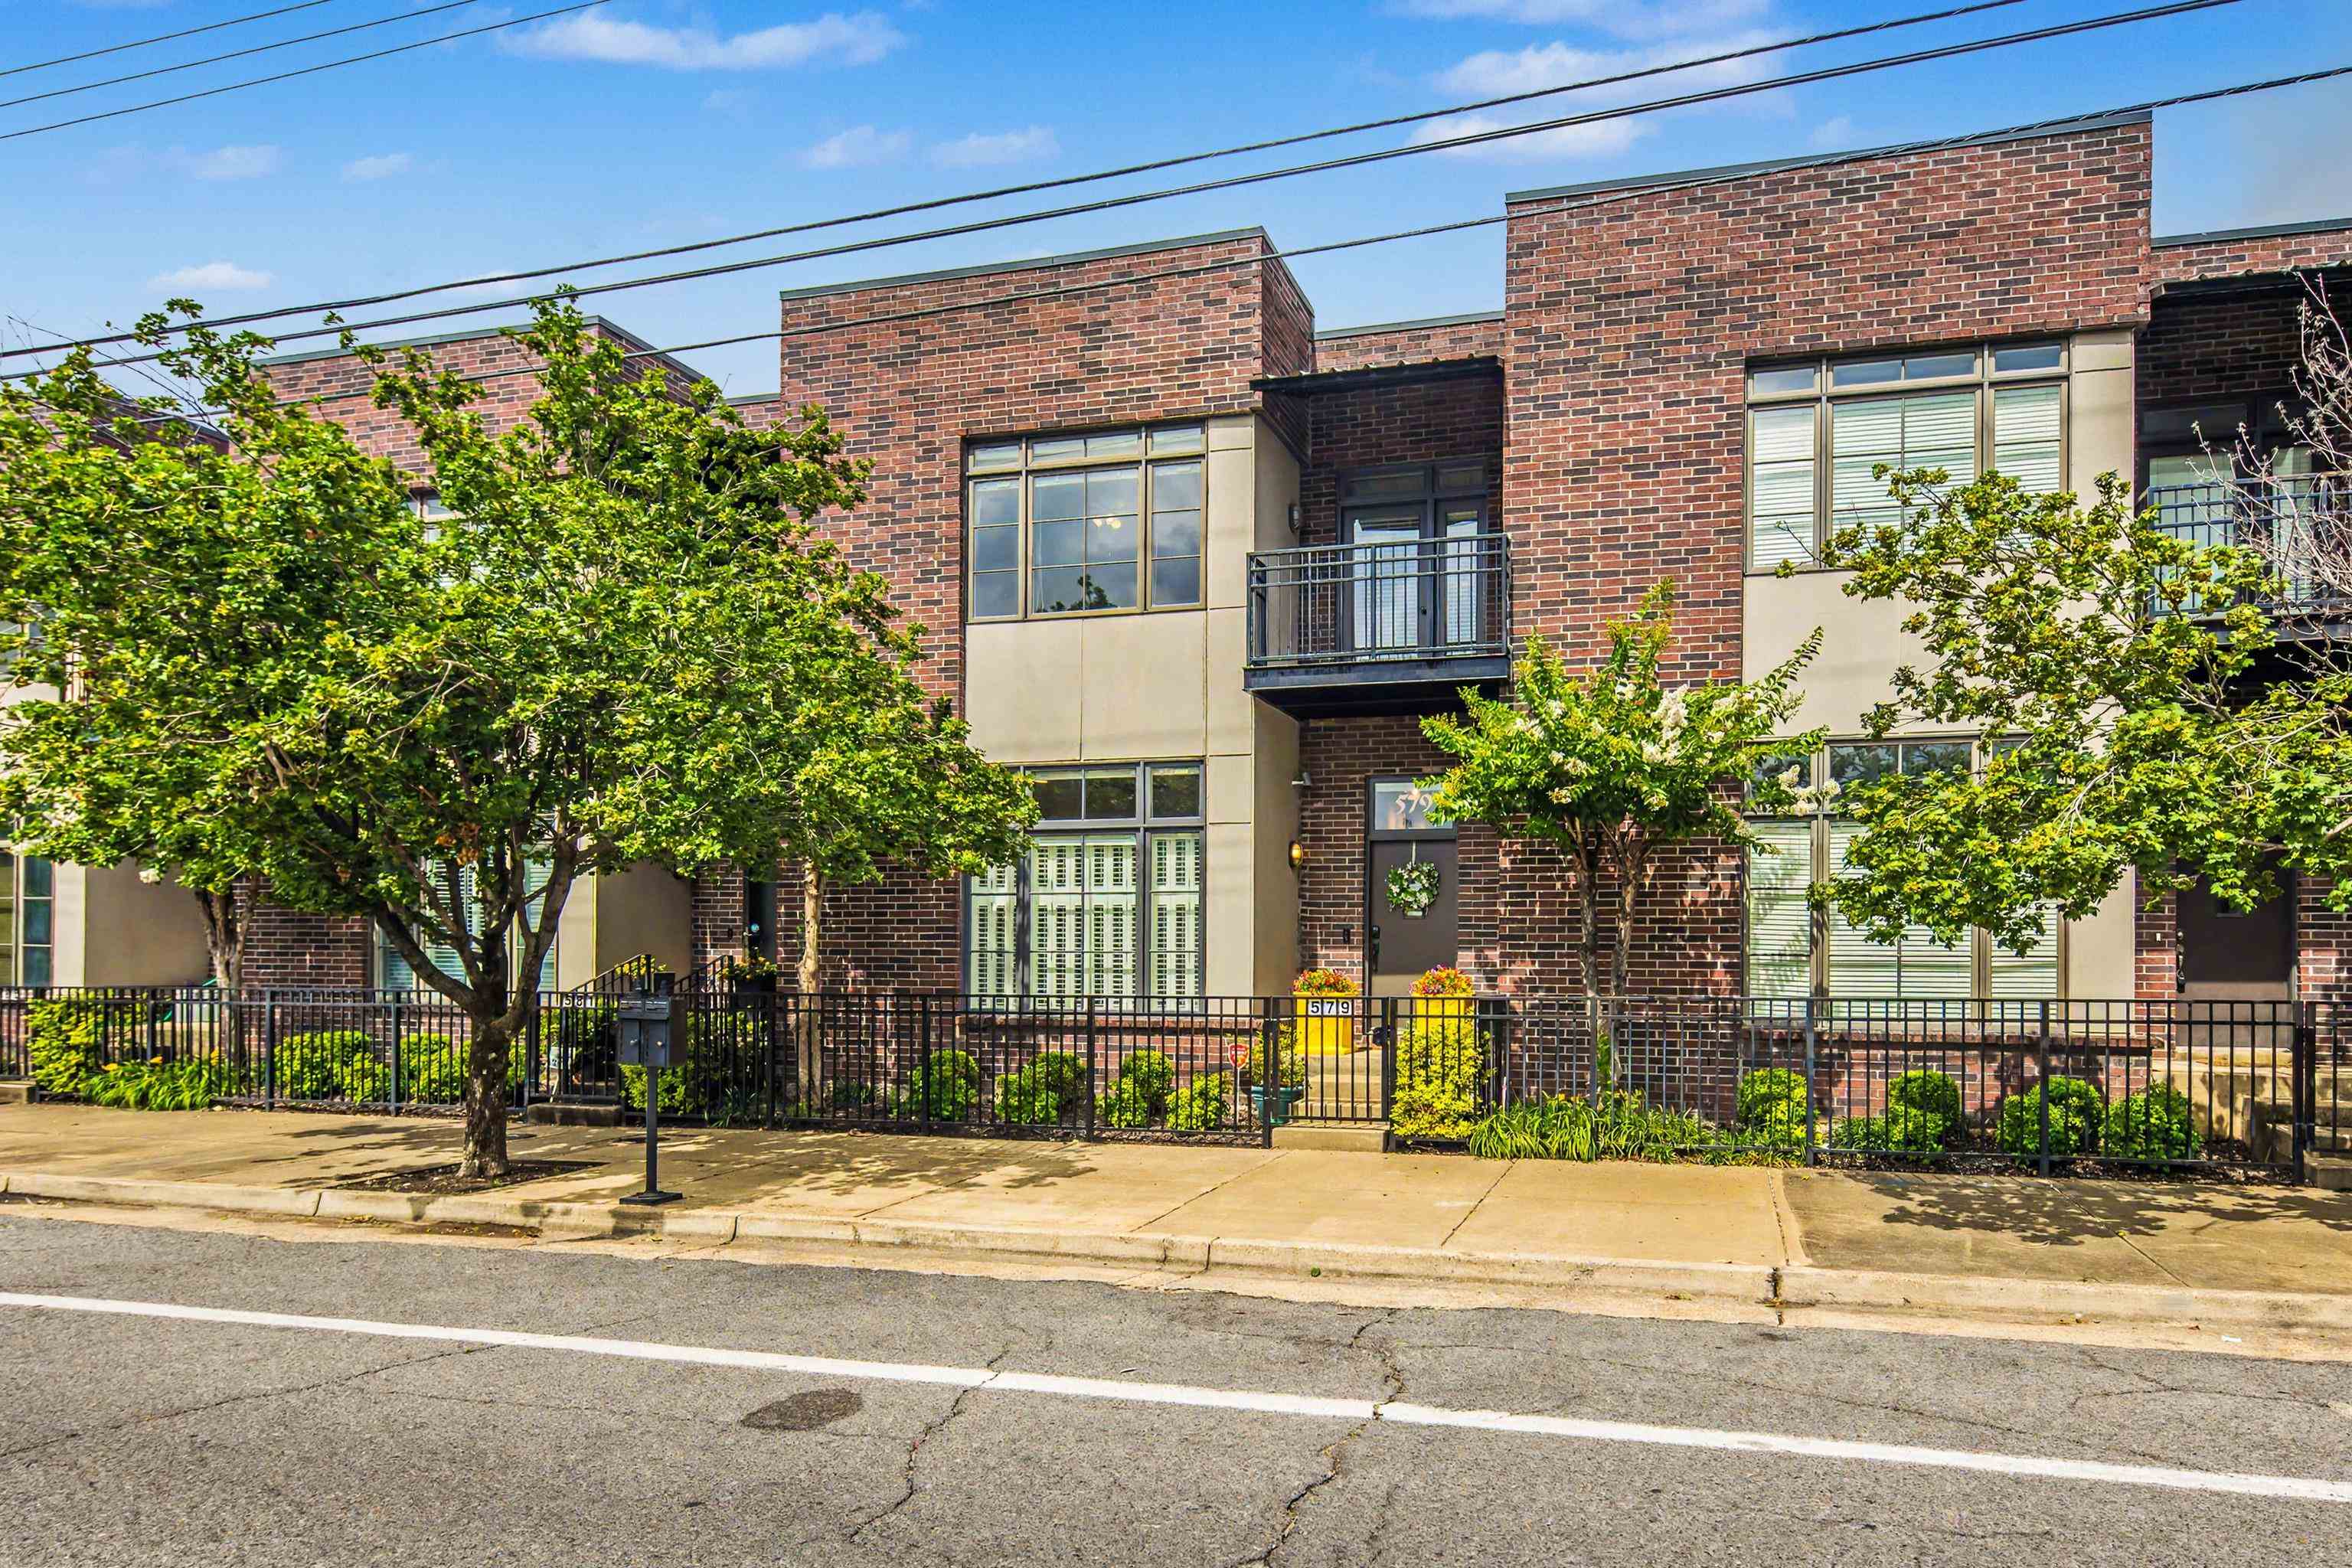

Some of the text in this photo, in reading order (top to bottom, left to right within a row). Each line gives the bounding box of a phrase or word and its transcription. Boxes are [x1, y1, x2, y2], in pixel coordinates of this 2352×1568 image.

[1395, 789, 1432, 815] 579
[565, 995, 593, 1007] 581
[1310, 1001, 1350, 1014] 579
